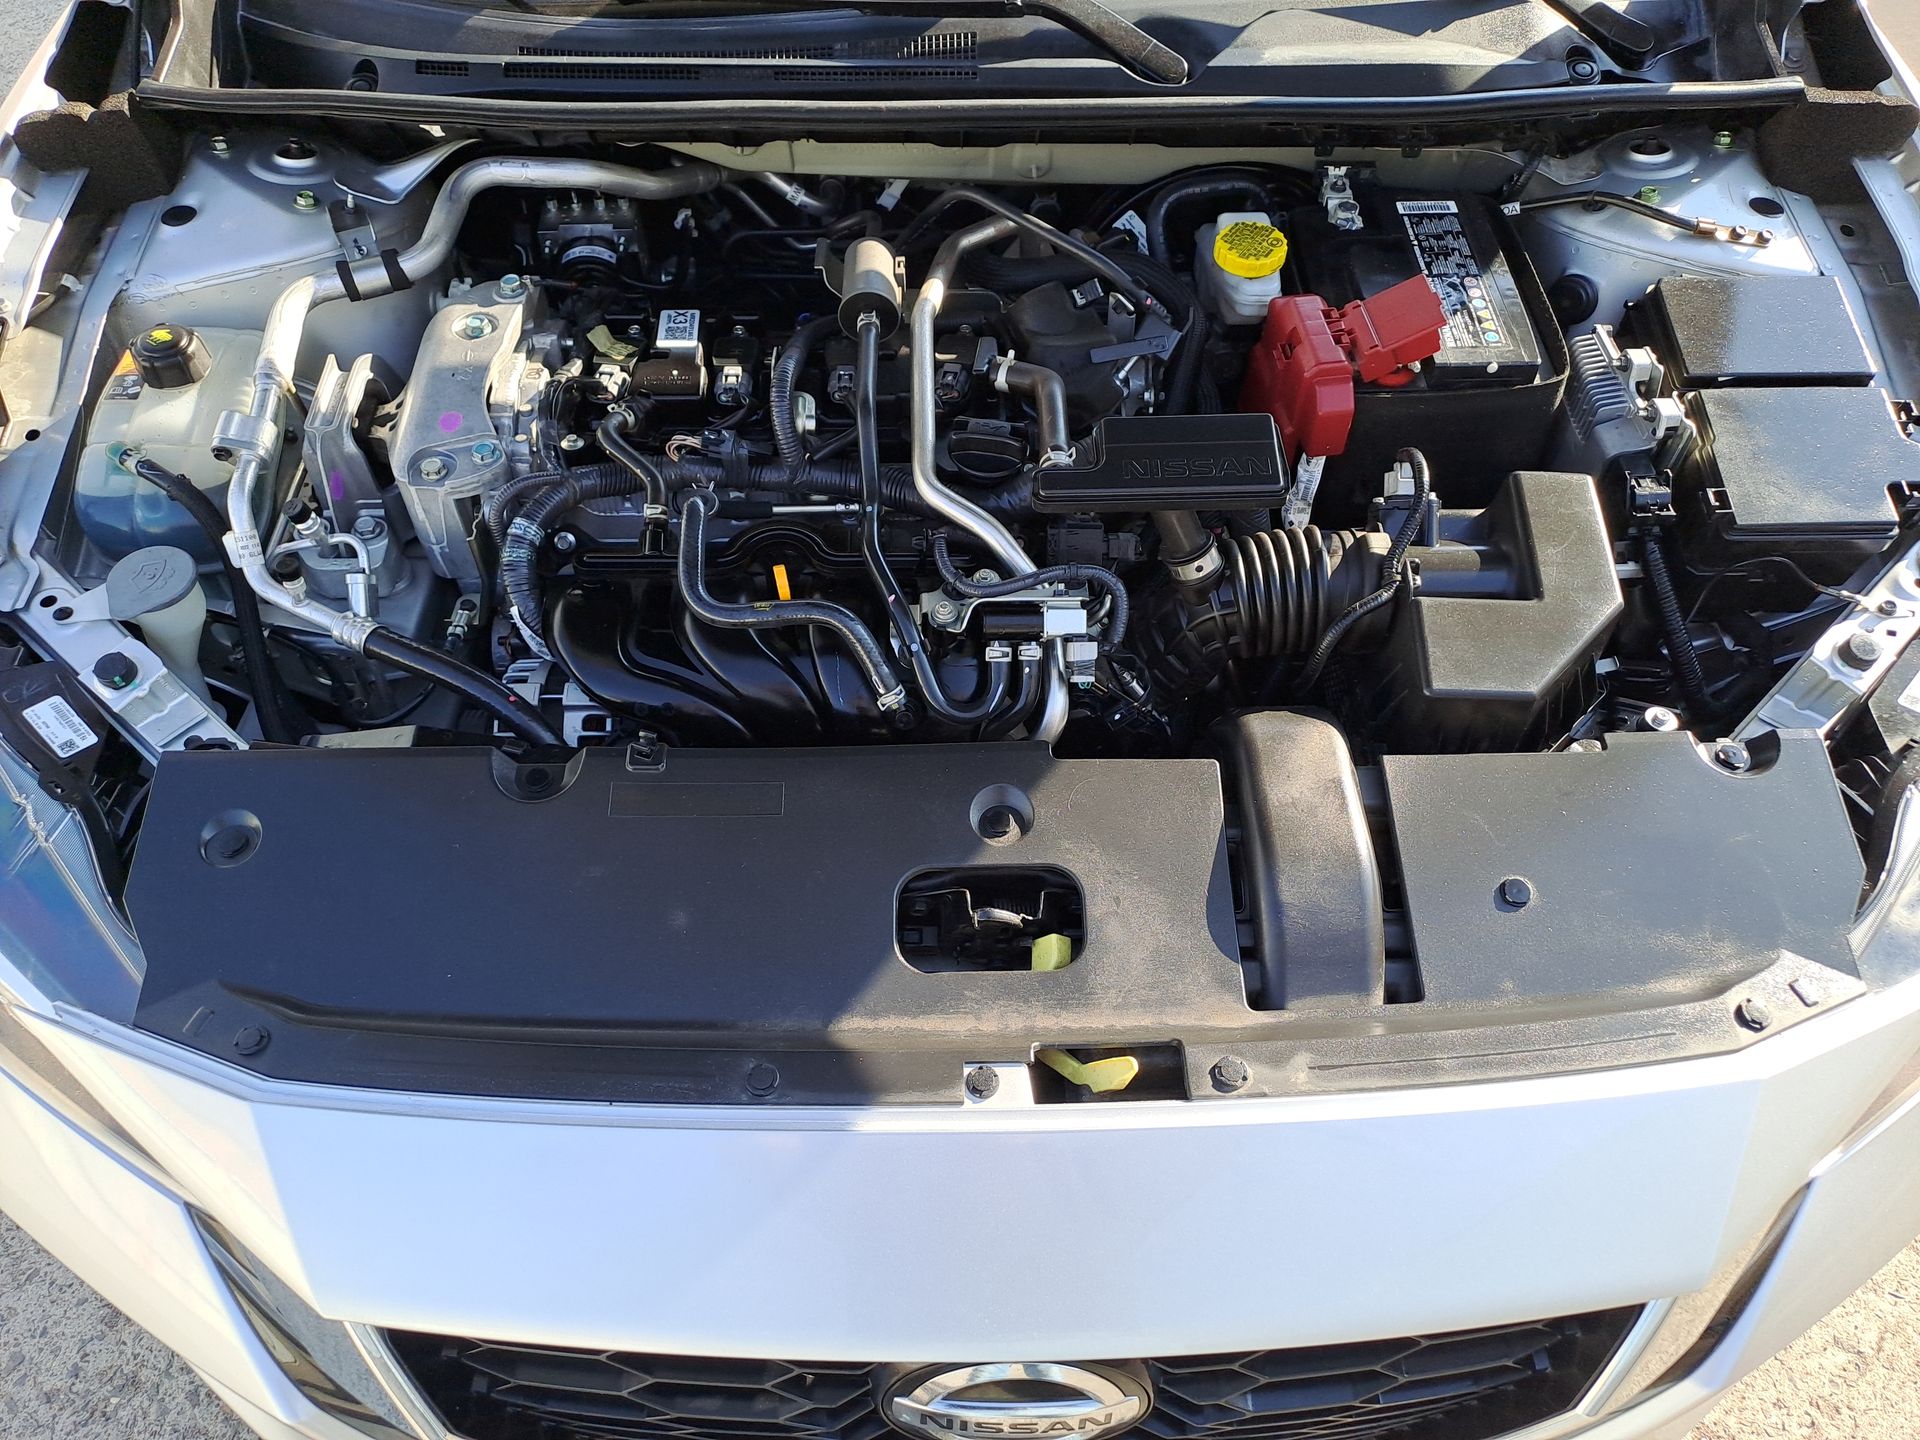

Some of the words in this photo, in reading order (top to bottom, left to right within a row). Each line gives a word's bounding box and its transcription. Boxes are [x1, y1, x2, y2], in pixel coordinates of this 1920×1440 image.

[672, 310, 689, 325] X3
[1122, 456, 1273, 479] NISSAN
[919, 1412, 1113, 1435] NISSAN
